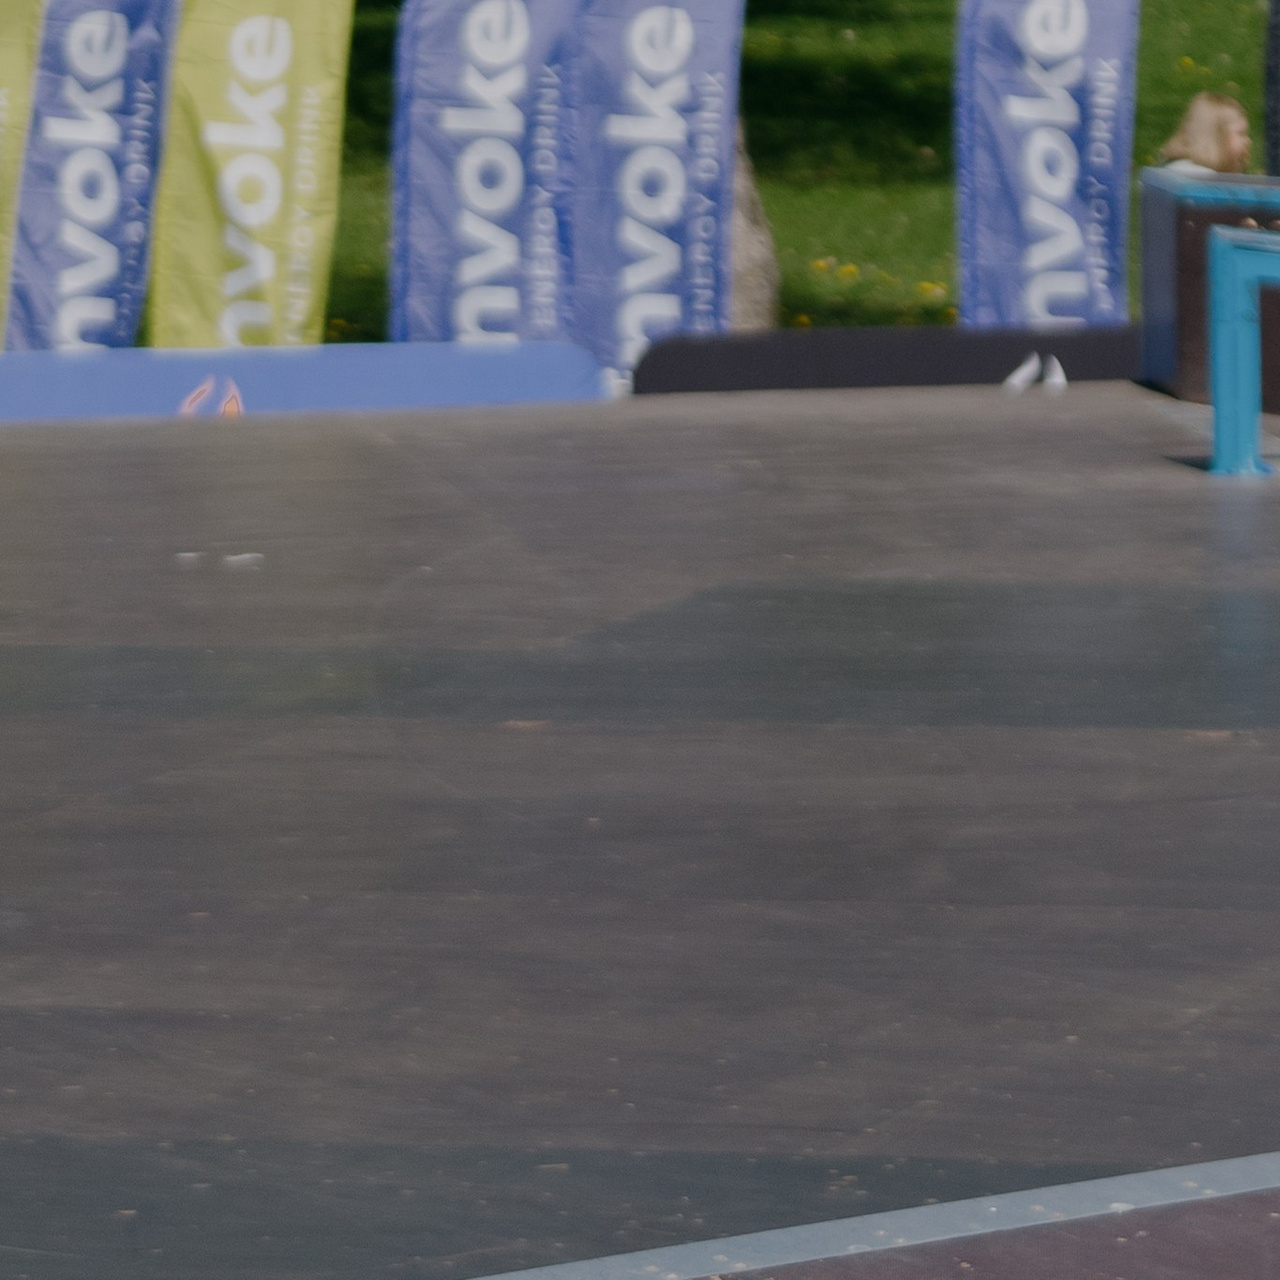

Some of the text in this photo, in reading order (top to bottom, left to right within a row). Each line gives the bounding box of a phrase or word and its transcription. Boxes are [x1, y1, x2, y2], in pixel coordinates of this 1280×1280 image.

[292, 82, 322, 193] DRINK
[697, 71, 726, 181] DRINK
[1086, 56, 1122, 165] DRINK
[531, 62, 561, 329] ENERGY DRINK
